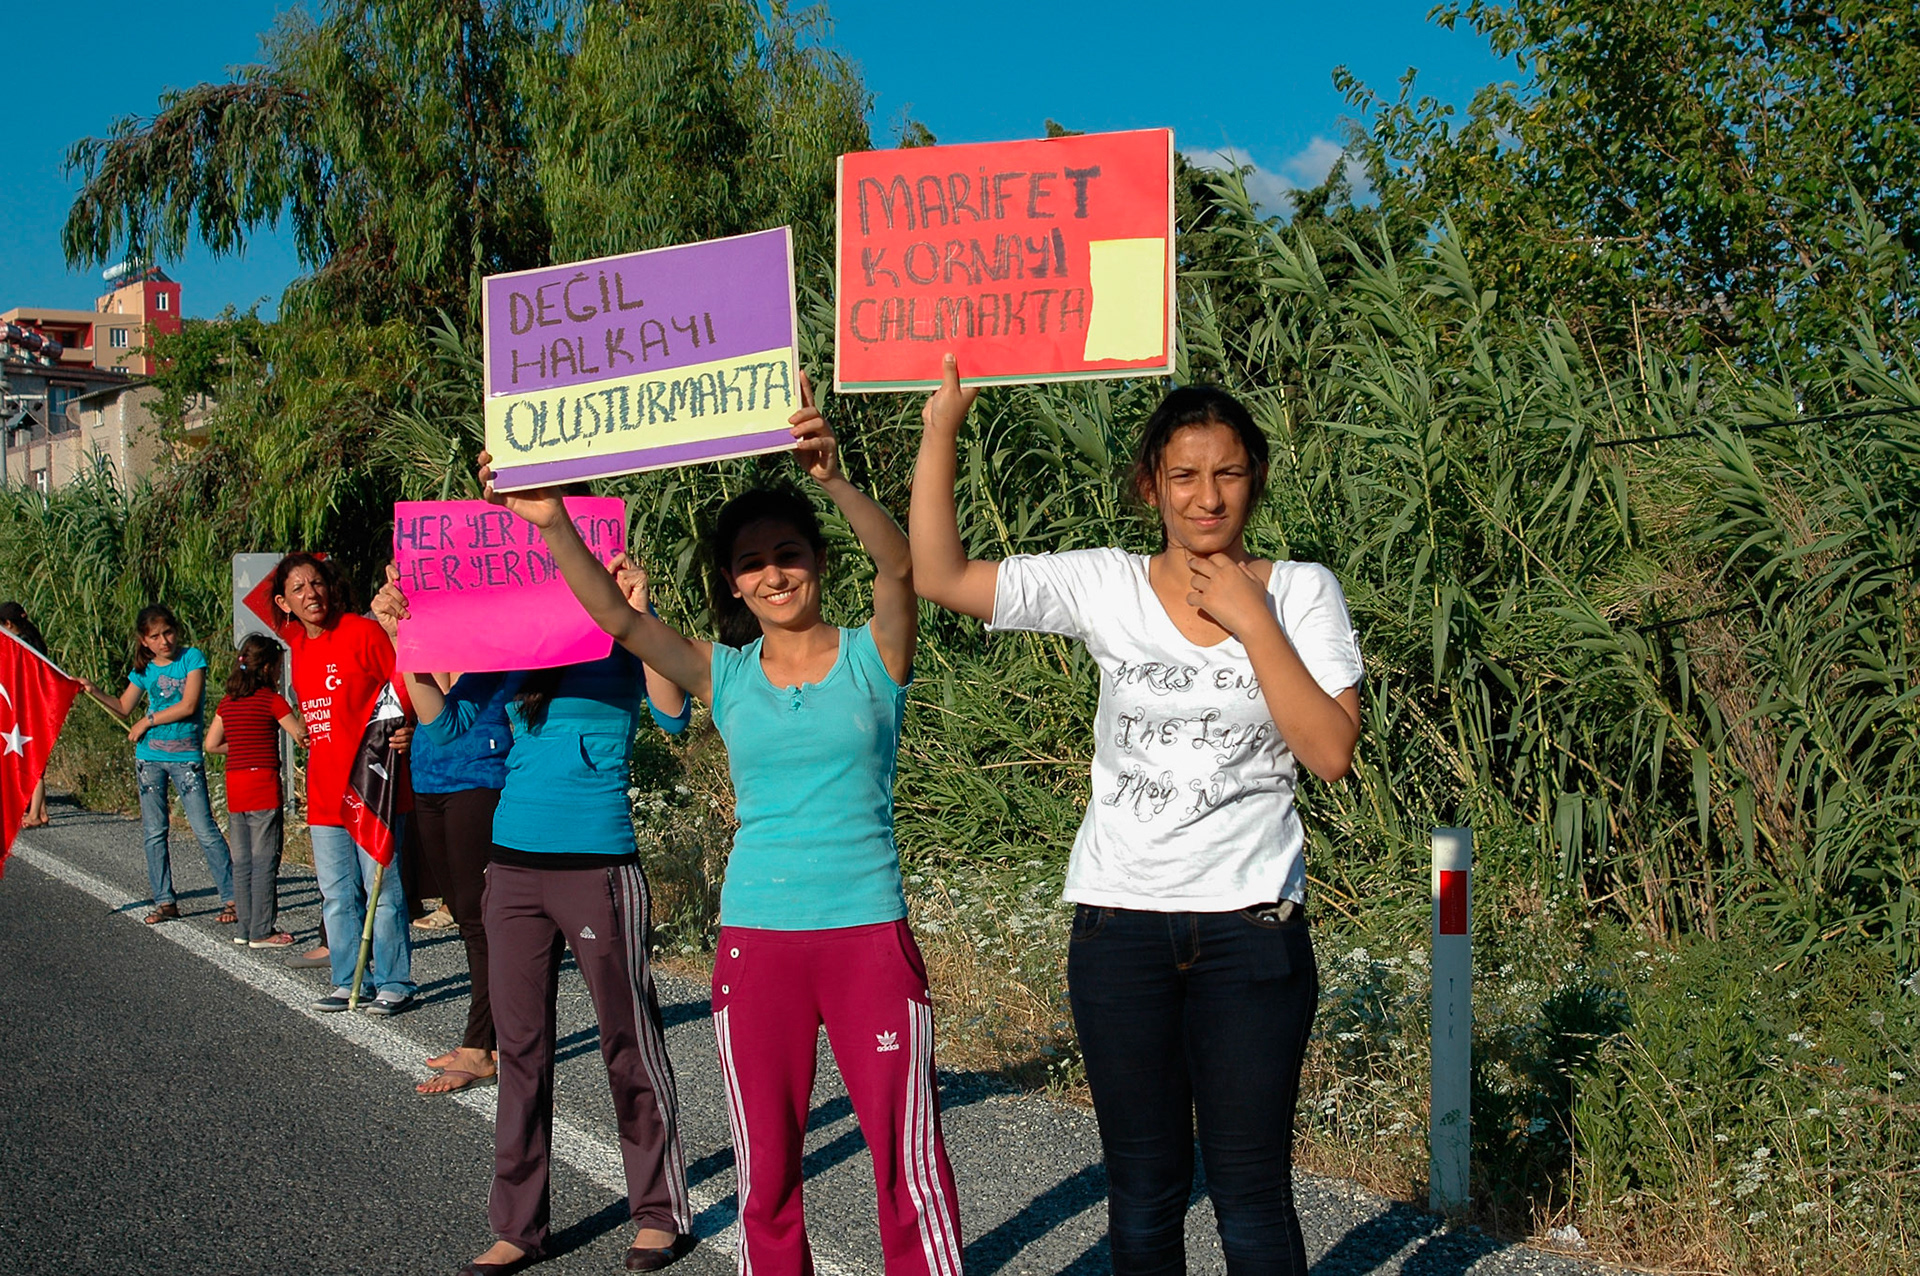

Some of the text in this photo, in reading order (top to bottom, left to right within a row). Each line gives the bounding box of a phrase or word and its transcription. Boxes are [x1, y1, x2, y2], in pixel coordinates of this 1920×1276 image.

[858, 165, 1101, 238] MARİFET
[861, 226, 1069, 288] KORNAYI
[509, 270, 644, 336] DEĞİL
[849, 288, 1085, 351] ÇALMAKTA
[511, 312, 717, 384] HALKAYI
[503, 359, 791, 453] OLUŞTURMAKTA
[397, 514, 456, 550] HER
[466, 511, 517, 549] YER
[397, 554, 463, 592] HER
[469, 550, 524, 589] YER
